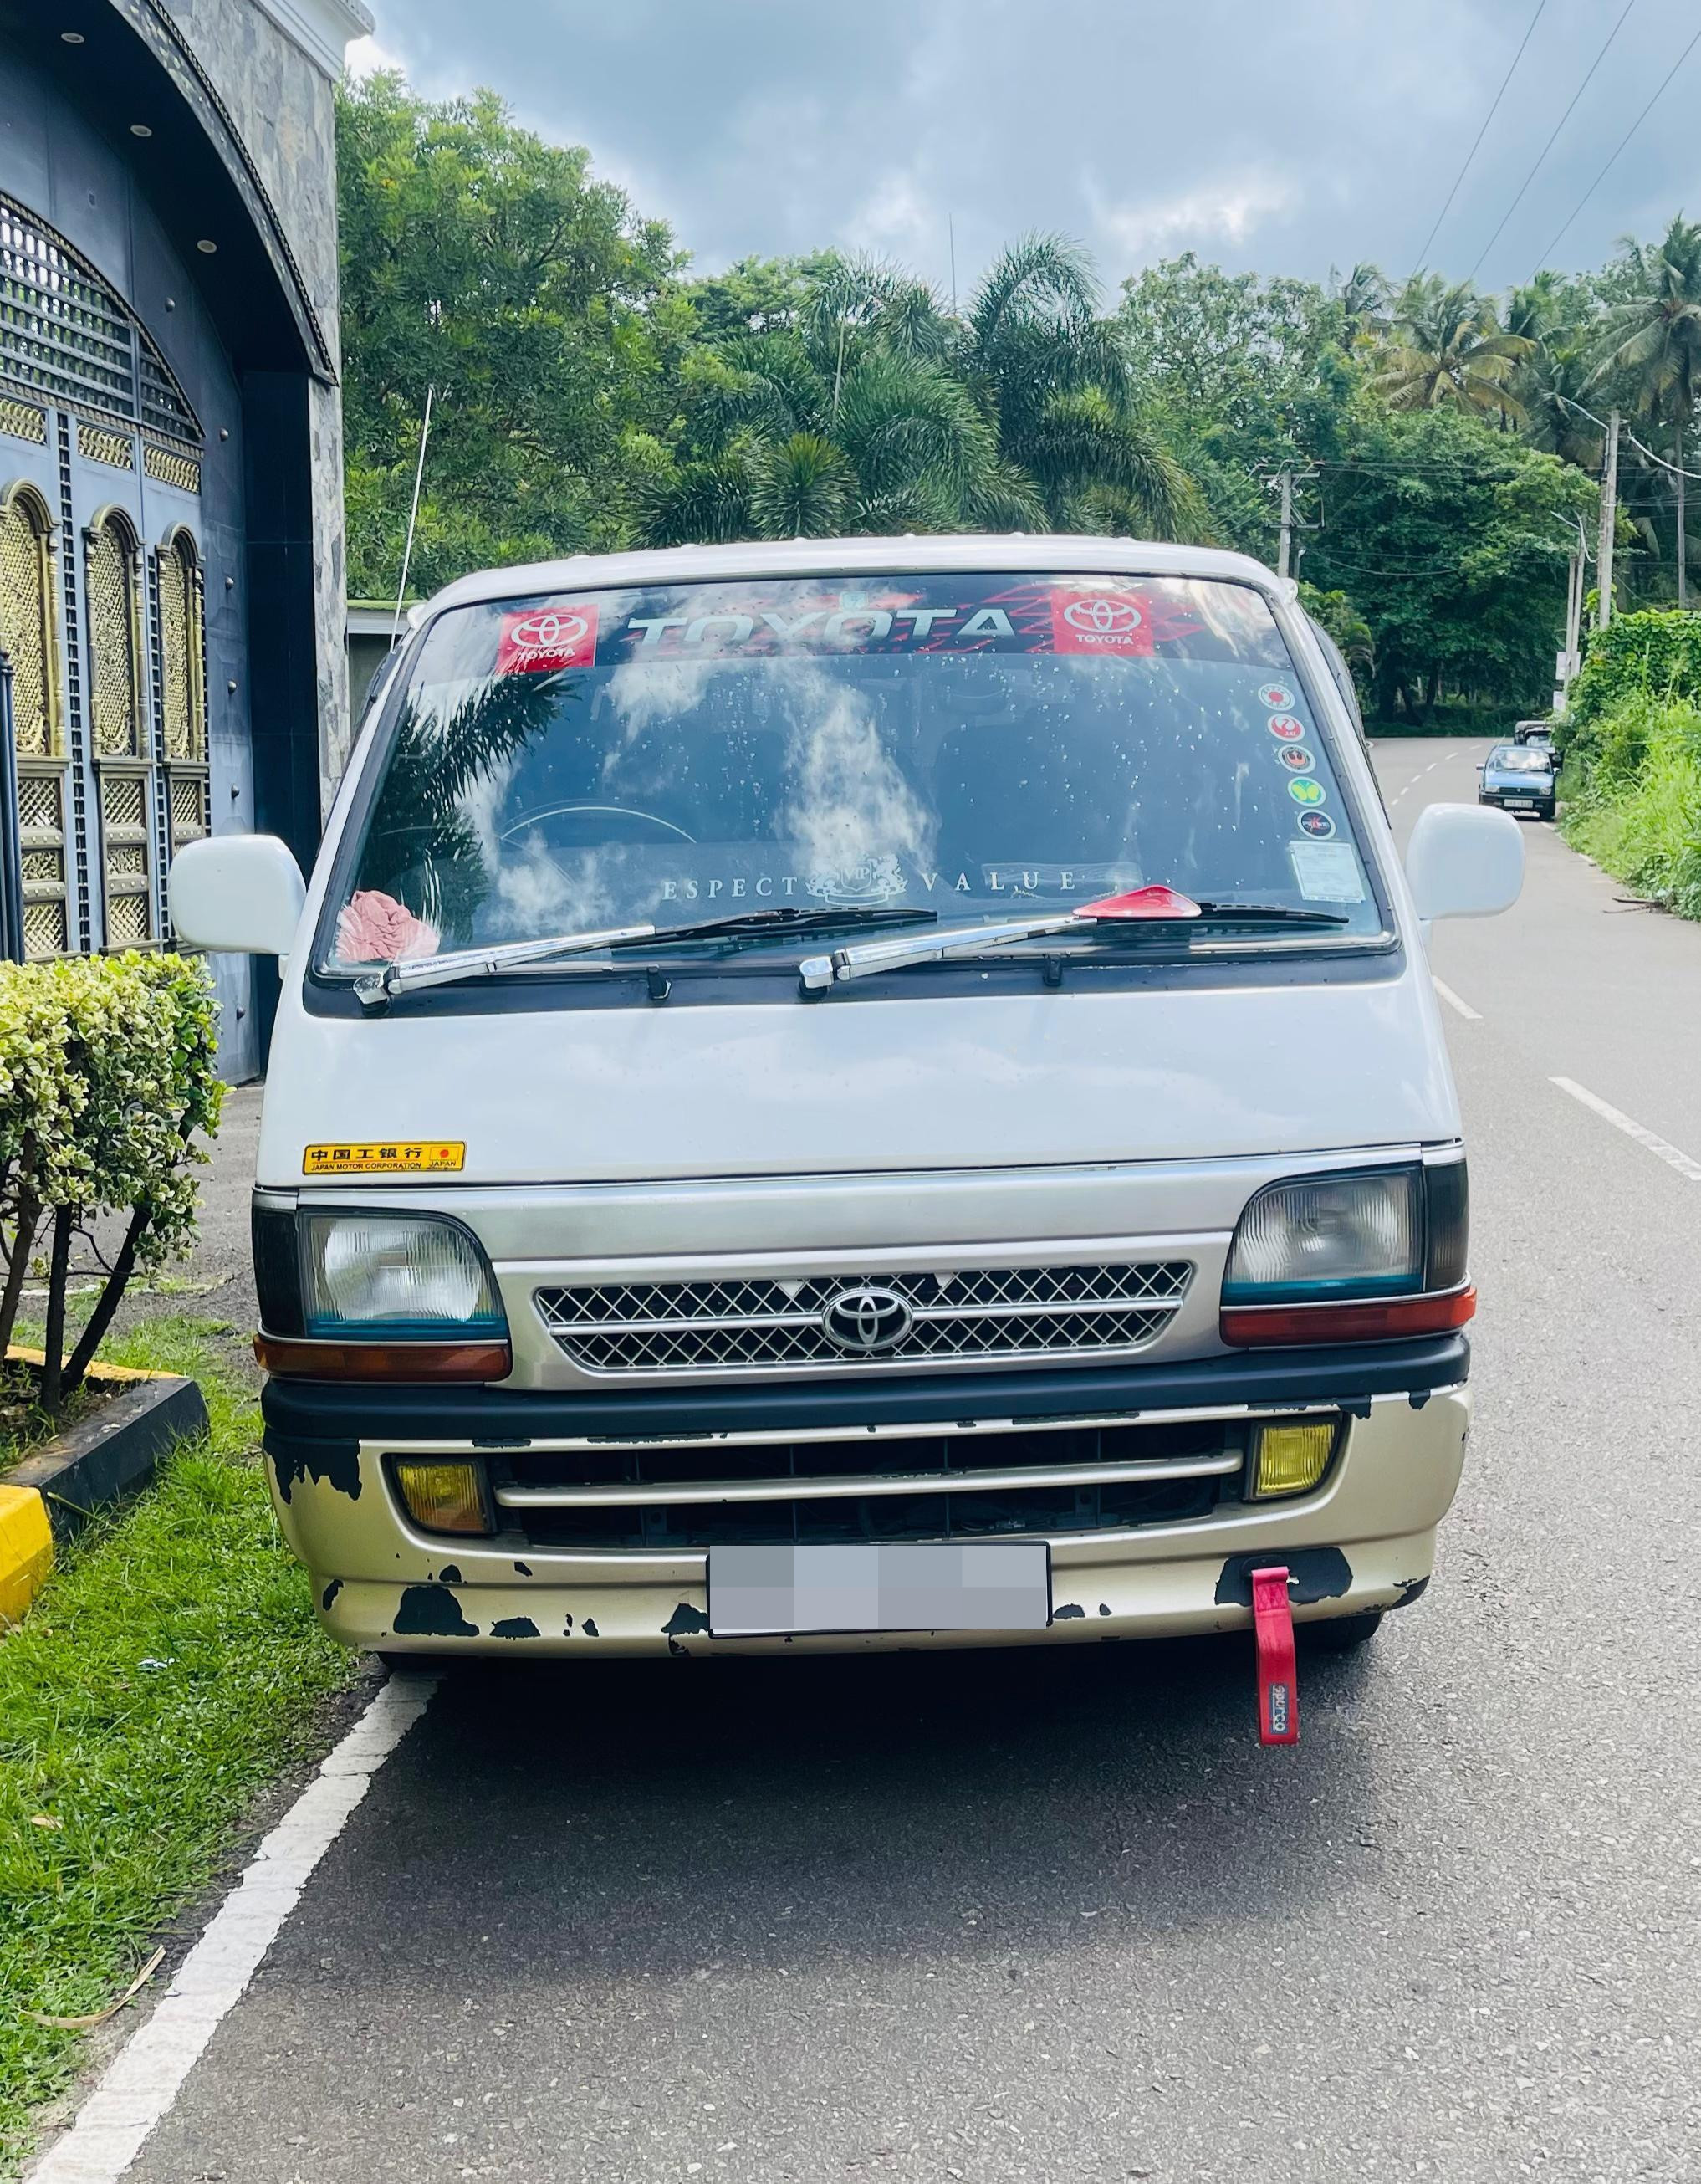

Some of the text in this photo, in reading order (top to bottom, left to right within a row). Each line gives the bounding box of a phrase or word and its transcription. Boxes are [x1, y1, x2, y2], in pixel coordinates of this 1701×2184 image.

[627, 608, 1016, 647] TOYOTA
[1075, 634, 1134, 645] TOYOTA
[662, 871, 1075, 901] ESPECT VALUE
[843, 867, 871, 880] VIP
[1272, 1685, 1286, 1732] sparco
